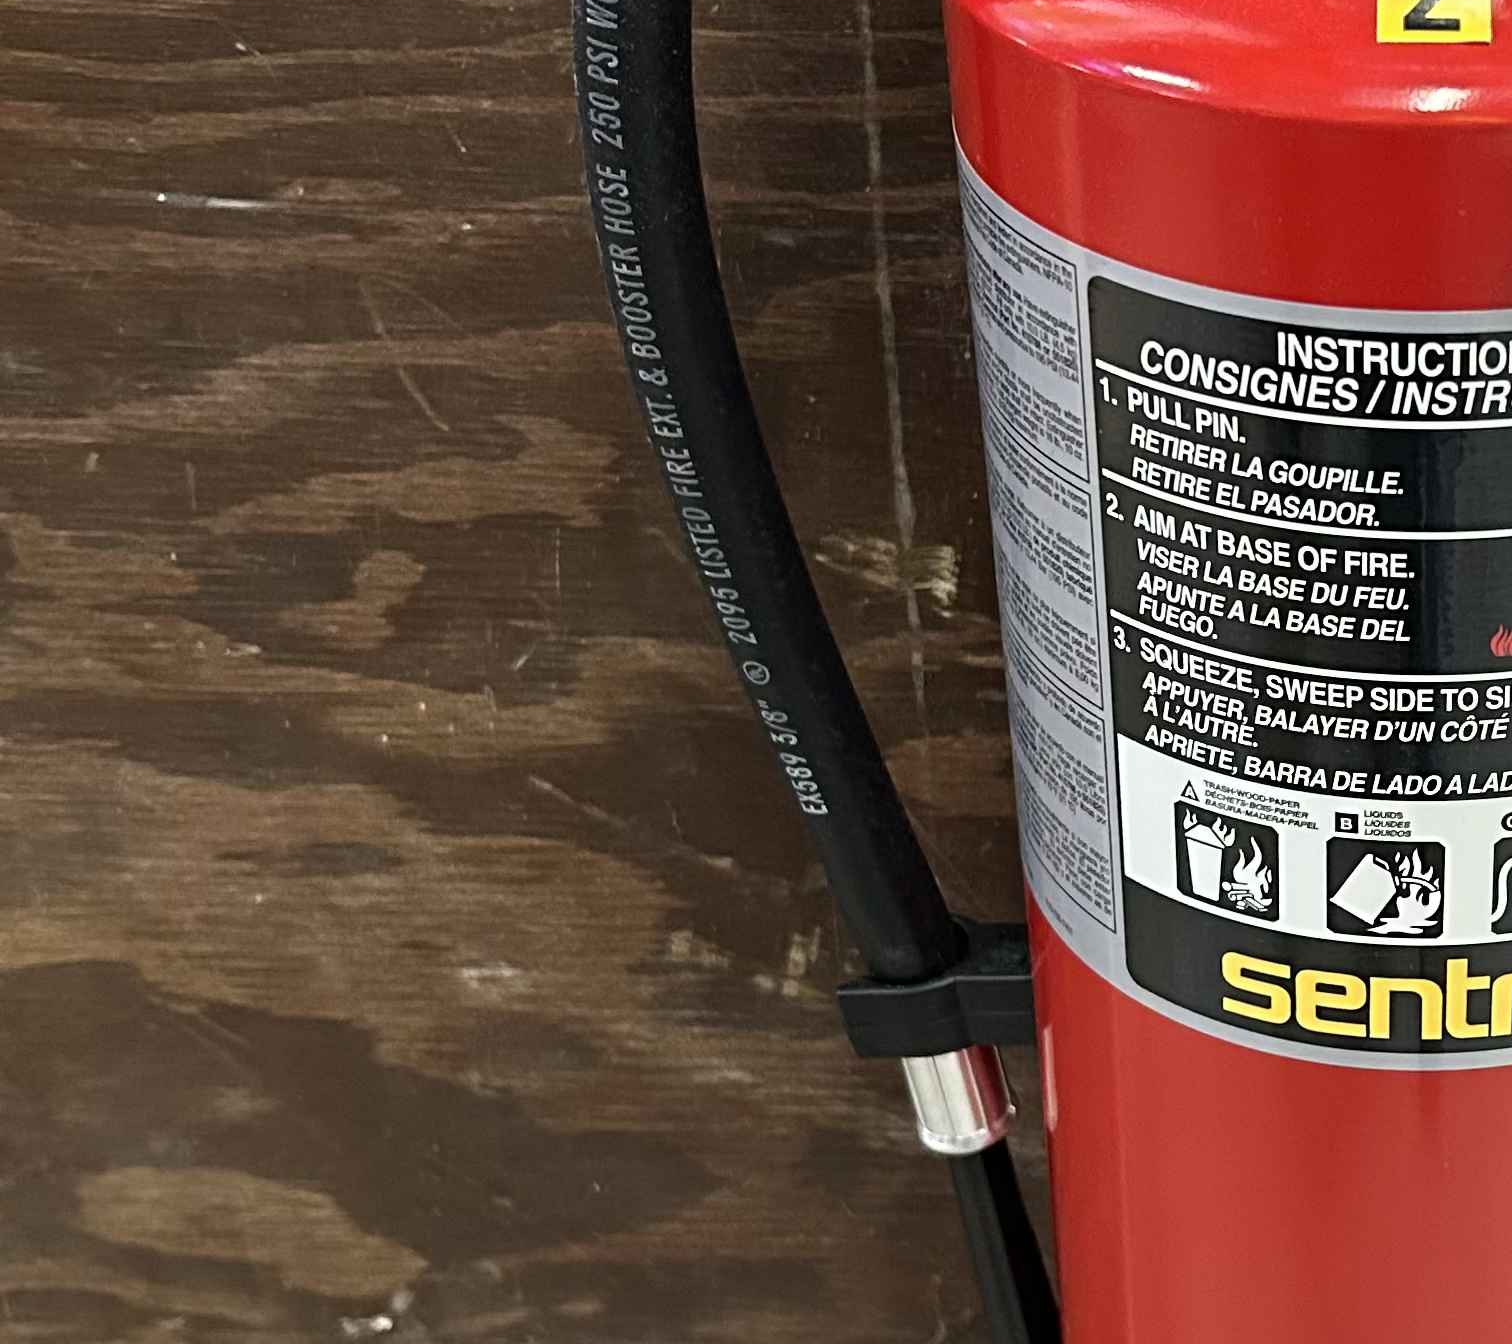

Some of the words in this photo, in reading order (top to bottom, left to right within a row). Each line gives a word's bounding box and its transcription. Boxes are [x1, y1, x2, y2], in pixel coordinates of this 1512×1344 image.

[587, 37, 619, 86] PSI
[589, 91, 625, 151] 250
[598, 164, 636, 236] HOSE
[609, 241, 662, 360] BOOSTER
[638, 365, 668, 387] &
[1099, 376, 1118, 406] 1.
[1127, 386, 1191, 430] PULL
[1195, 407, 1247, 443] PIN.
[1140, 340, 1359, 413] CONSIGNES
[645, 391, 683, 440] EXT.
[661, 446, 704, 498] FIRE
[1130, 423, 1227, 473] RETIRER
[1231, 452, 1264, 481] LA
[1268, 460, 1404, 494] GOUPILLE.
[1132, 456, 1210, 501] RETIRE
[1216, 481, 1245, 509] EL
[1250, 490, 1380, 527] PASADOR.
[682, 506, 732, 579] LISTED
[1105, 492, 1125, 521] 2.
[1133, 504, 1176, 541] AIM
[1180, 520, 1212, 550] AT
[1217, 529, 1291, 569] BASE
[1297, 545, 1337, 573] OF
[1344, 550, 1415, 578] FIRE.
[1136, 538, 1200, 579] VISER
[1203, 561, 1234, 588] LA
[1238, 570, 1306, 602] BASE
[1310, 581, 1349, 606] DU
[1354, 587, 1410, 610] FEU.
[1137, 571, 1226, 617] APUNTE
[1227, 600, 1247, 622] A
[1250, 604, 1281, 629] LA
[1286, 613, 1356, 639] BASE
[1360, 619, 1411, 642] DEL
[710, 586, 757, 644] 2095
[1139, 595, 1219, 640] FUEGO.
[1113, 626, 1131, 653] 3.
[1139, 637, 1260, 699] SQUEEZE,
[1266, 674, 1364, 709] SWEEP
[1370, 687, 1434, 712] SIDE
[1440, 687, 1482, 712] TO
[1142, 671, 1249, 723] APPUYER,
[1254, 704, 1368, 740] BALAYER
[1374, 718, 1436, 743] D'UN
[1440, 713, 1510, 743] CÔTÉ
[1163, 704, 1259, 748] L'AUTRE.
[1145, 725, 1238, 776] APRIETE,
[1243, 755, 1327, 789] BARRA
[1332, 770, 1367, 792] DE
[1371, 773, 1442, 795] LADO
[1445, 773, 1463, 795] A
